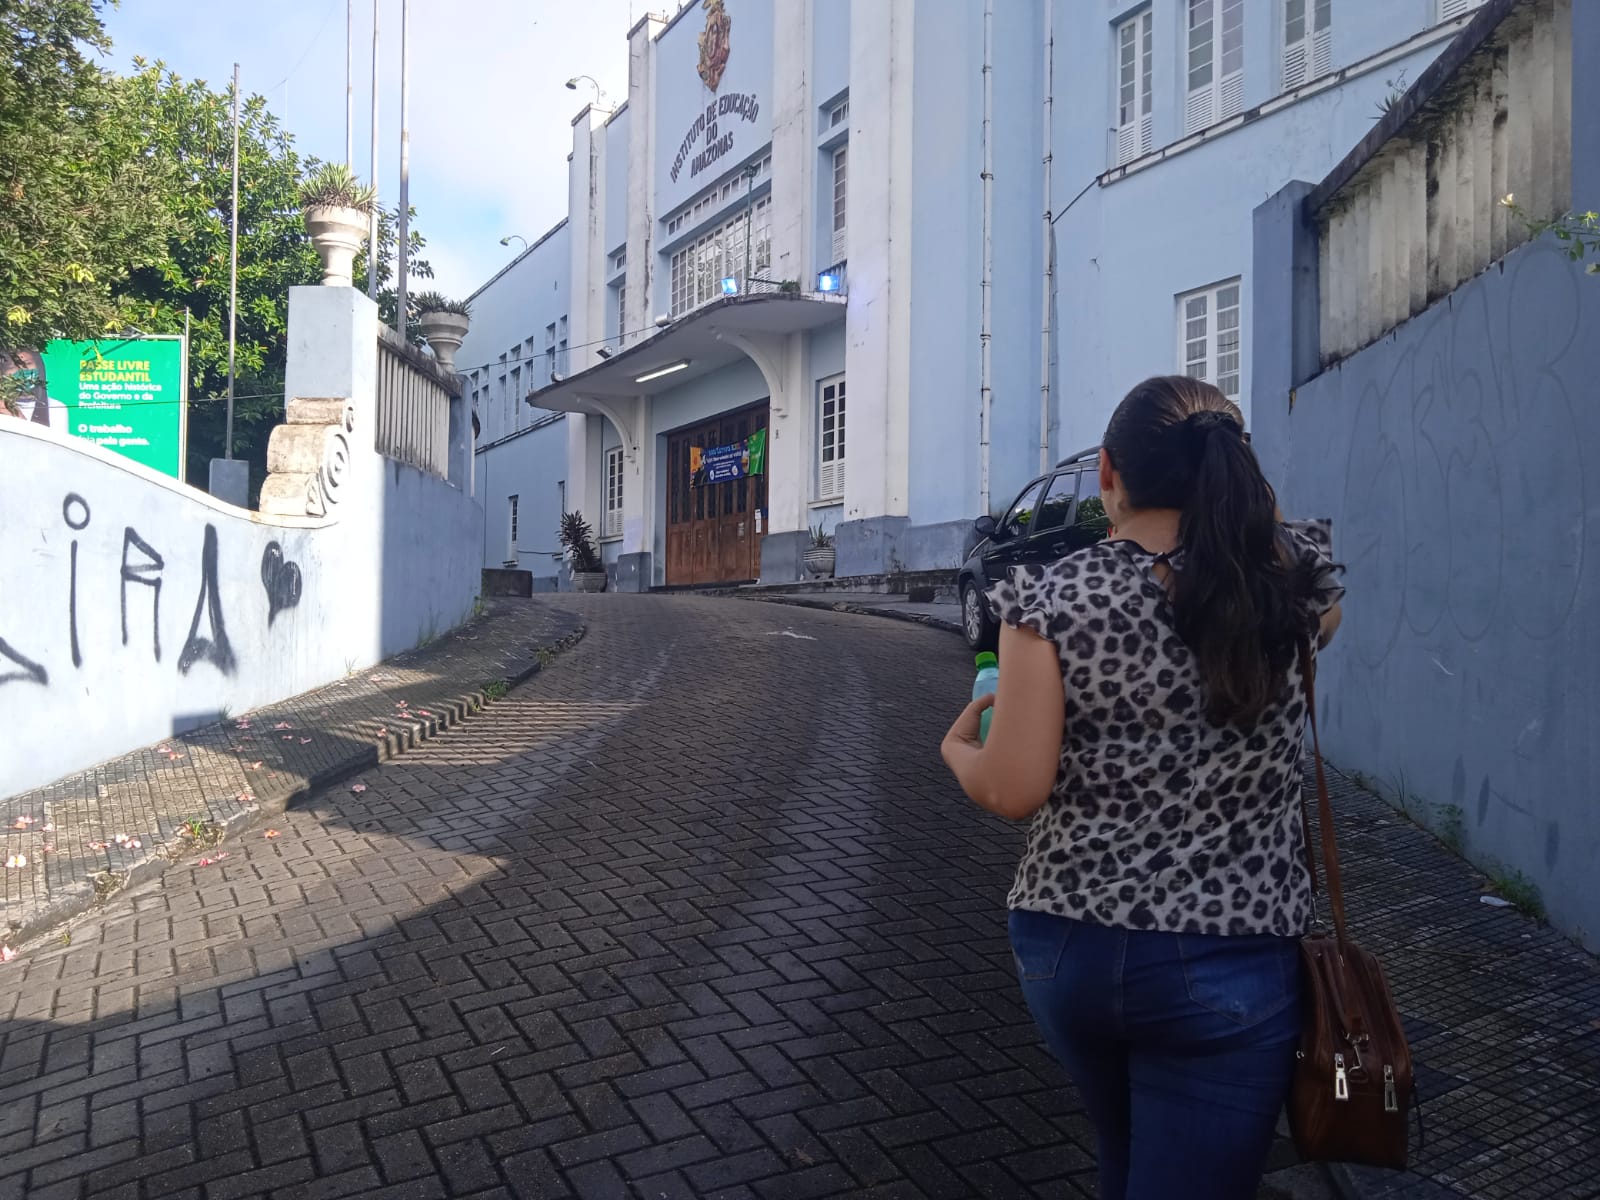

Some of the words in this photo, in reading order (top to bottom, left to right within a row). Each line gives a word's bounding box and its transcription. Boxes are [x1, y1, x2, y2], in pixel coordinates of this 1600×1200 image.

[670, 113, 705, 184] INSTITUTO
[706, 100, 717, 125] DE
[718, 93, 759, 123] EDUCAÇÃO
[706, 122, 718, 146] DO
[690, 131, 733, 178] AMAZONAS
[80, 360, 116, 370] PASSE
[117, 360, 150, 370] LIVRE
[79, 372, 151, 382] ESTUDANTIL
[79, 383, 99, 391] Uma
[101, 383, 122, 392] ação
[79, 392, 91, 400] do
[93, 392, 132, 400] Governo
[78, 424, 88, 434] O
[89, 424, 133, 434] trabalho
